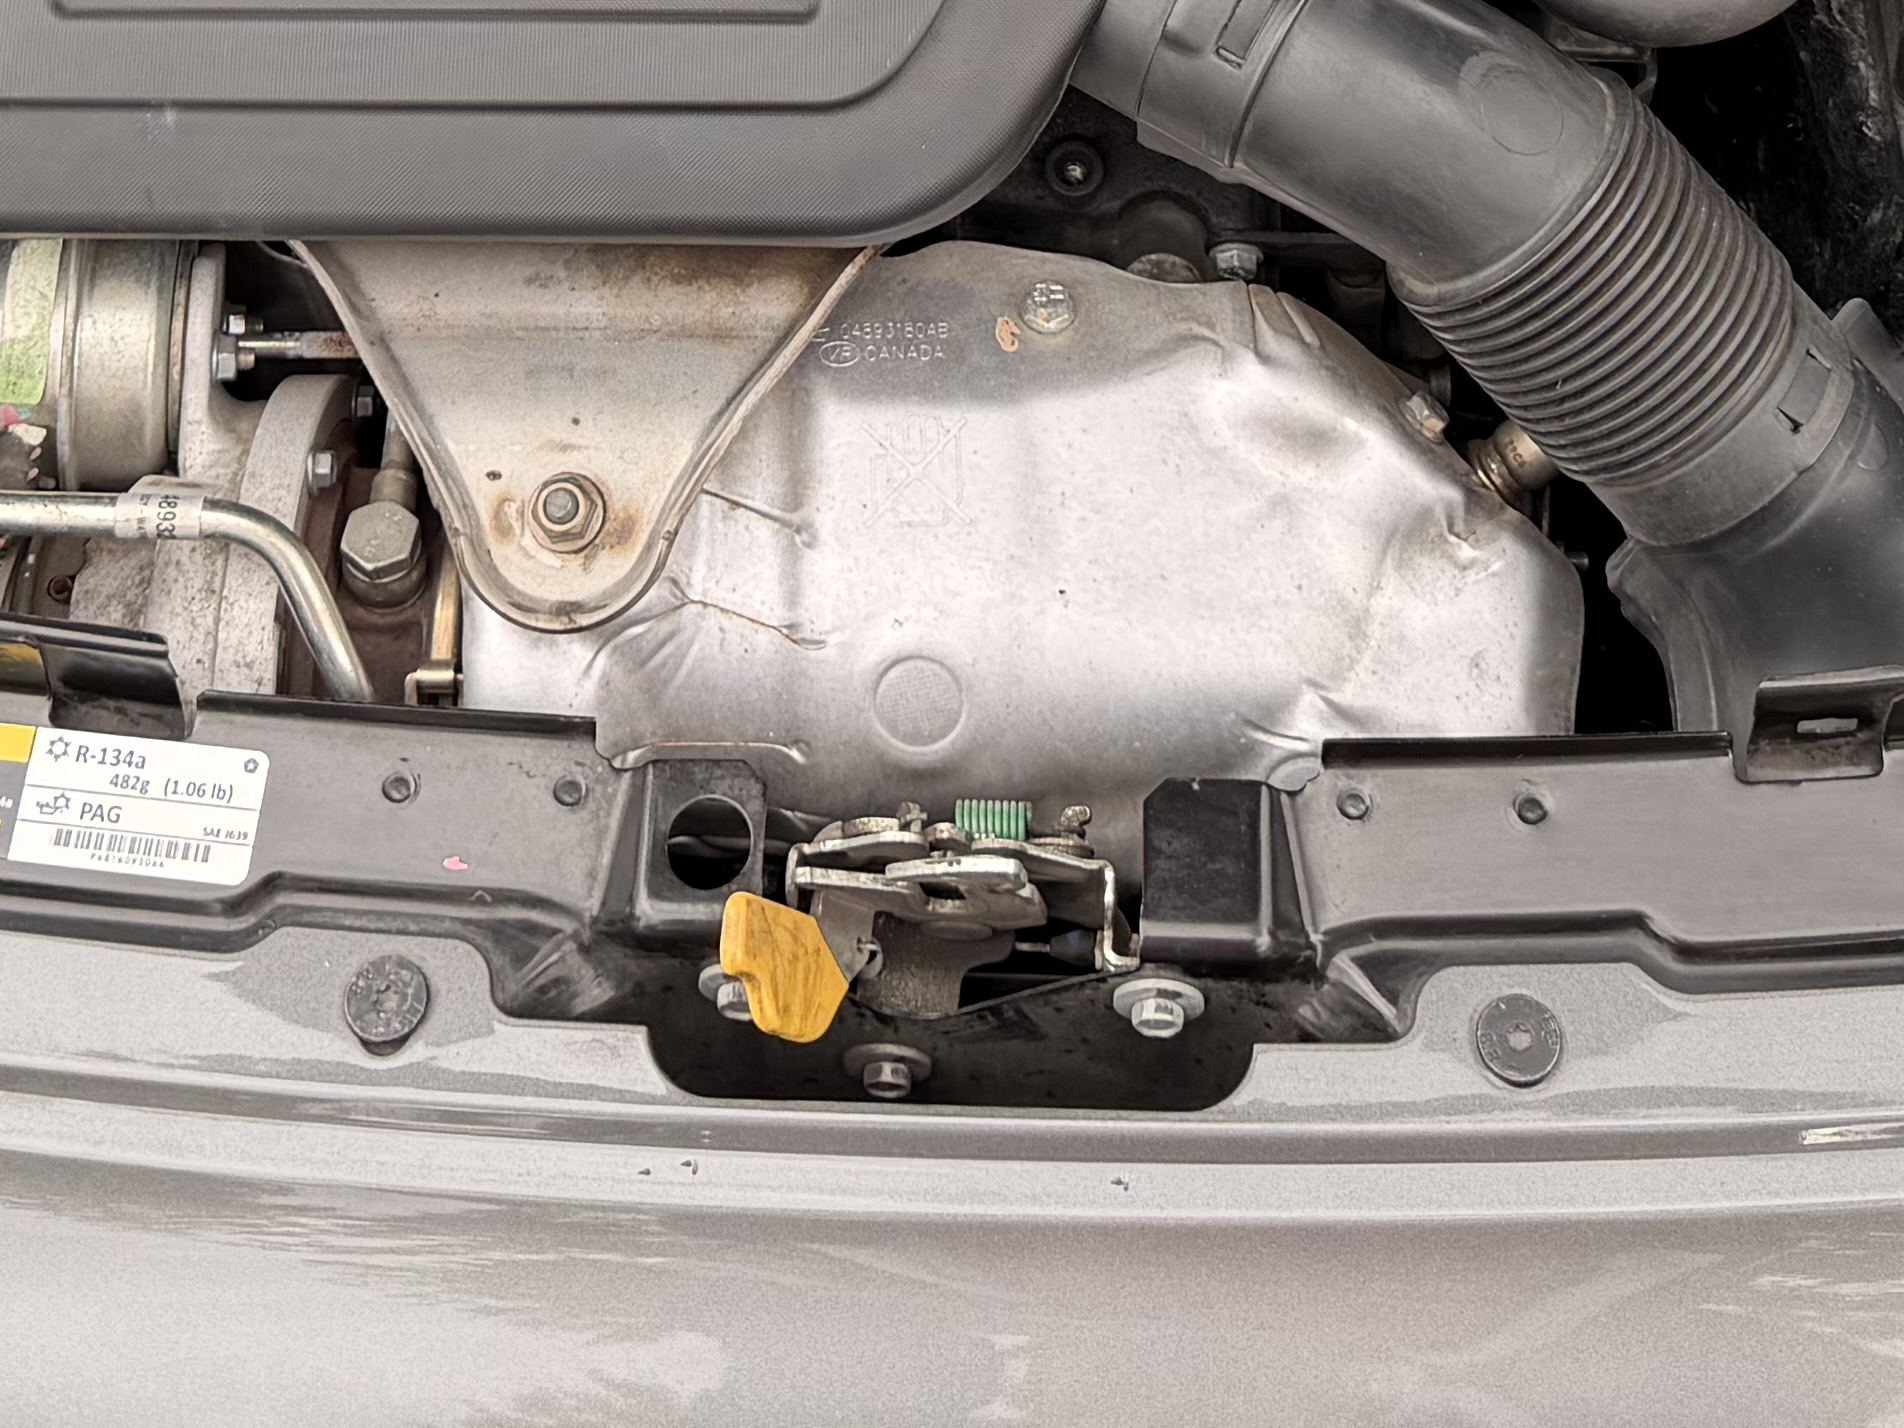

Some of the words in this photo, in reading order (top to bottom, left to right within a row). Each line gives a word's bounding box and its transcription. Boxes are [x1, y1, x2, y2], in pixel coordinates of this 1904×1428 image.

[864, 345, 945, 362] CANADA
[75, 745, 146, 769] R-134a
[110, 773, 150, 795] 482g
[164, 778, 207, 800] (1.06
[211, 782, 234, 803] lb)
[79, 802, 123, 823] PAG
[203, 826, 222, 837] SAE
